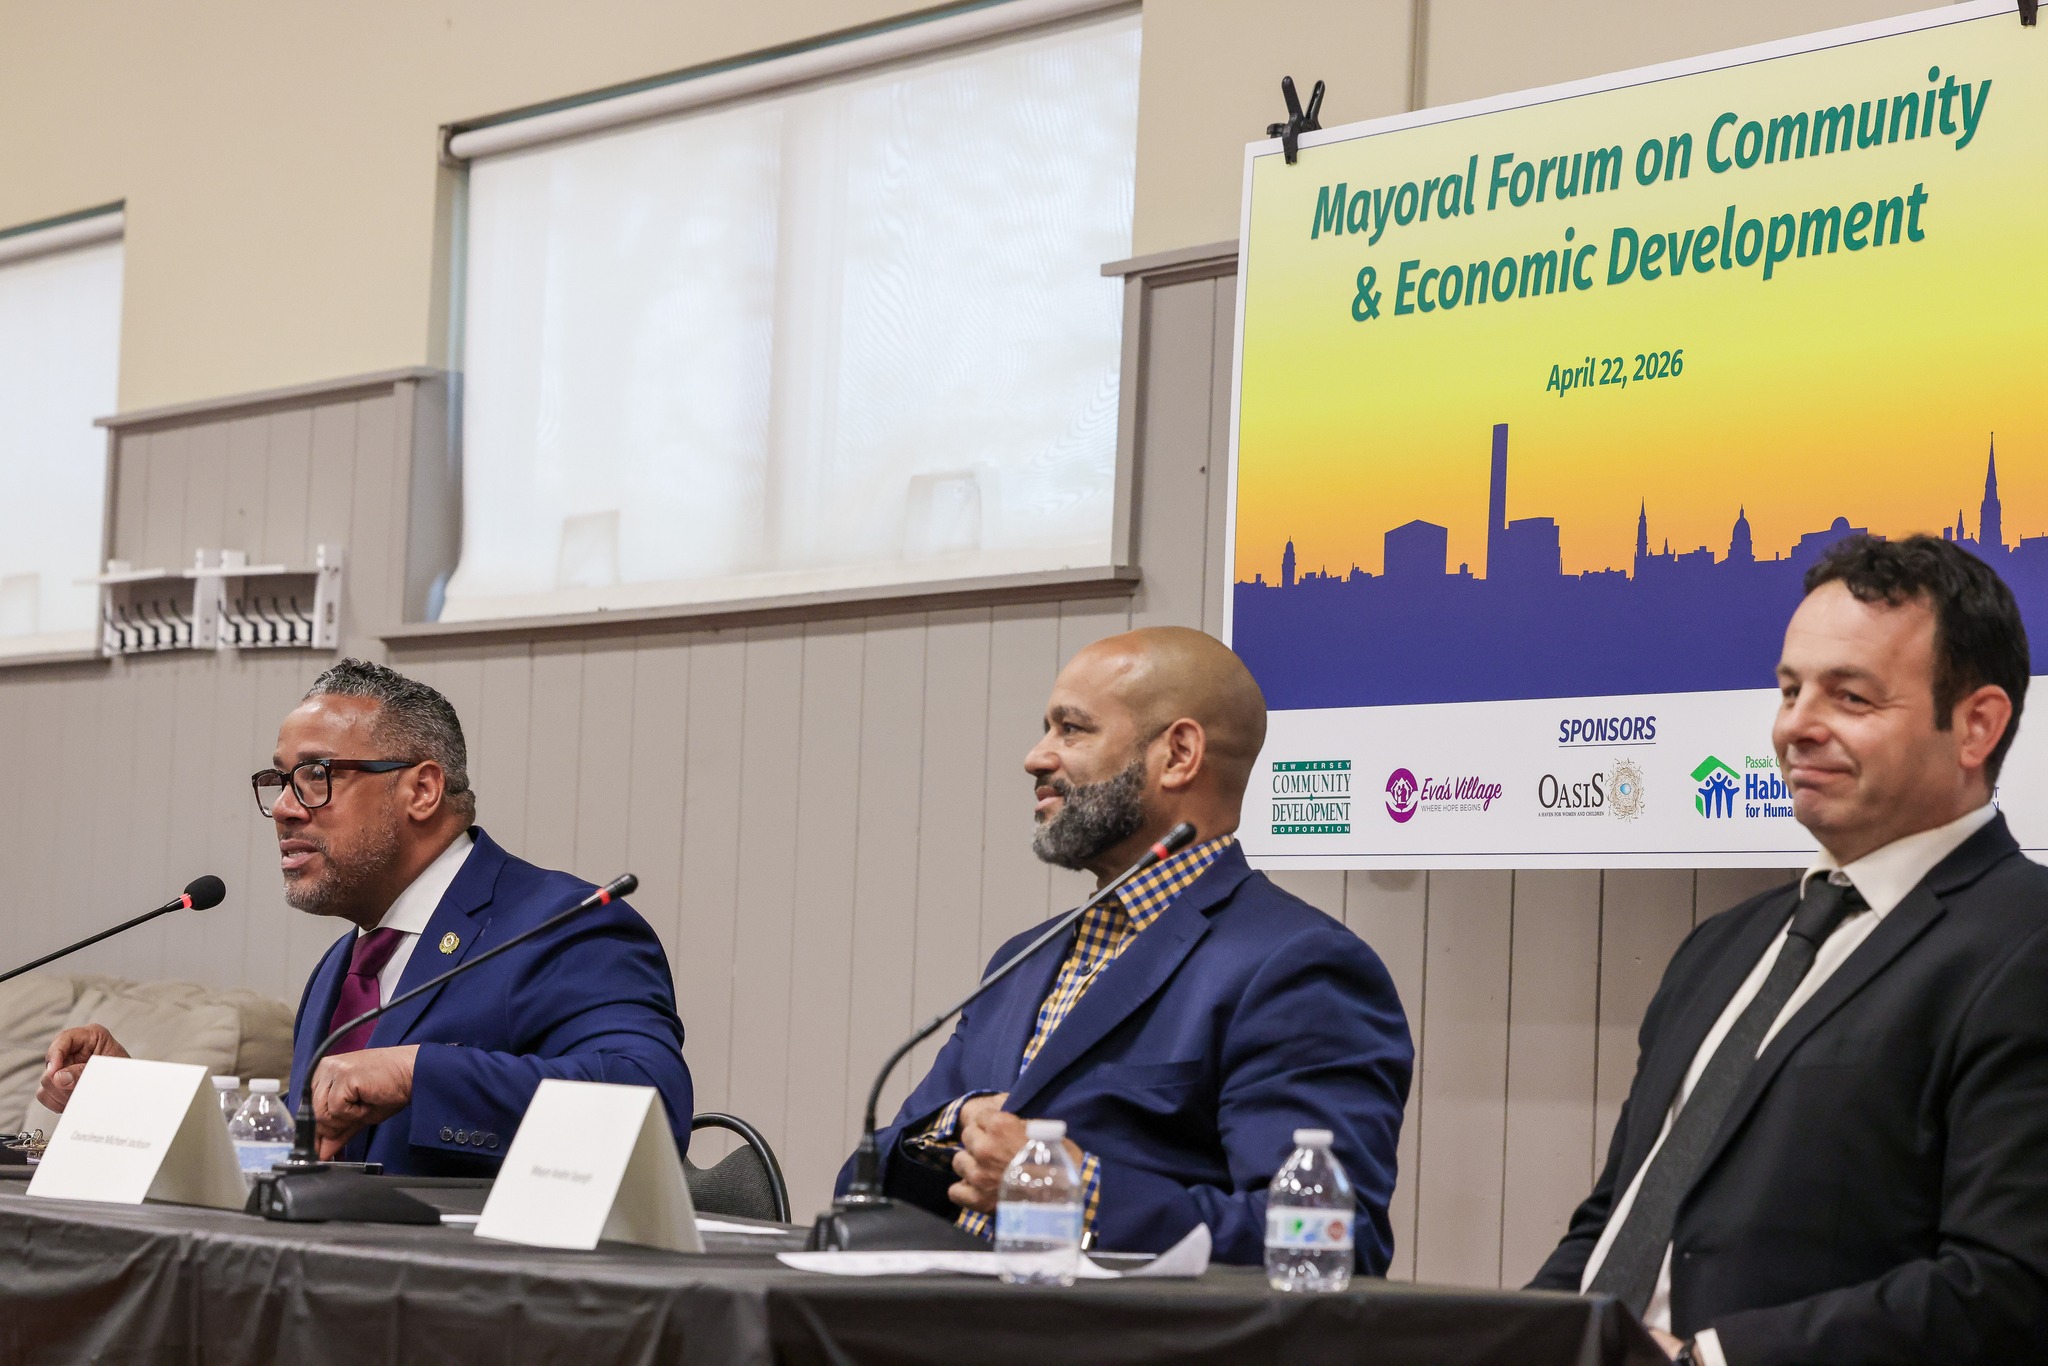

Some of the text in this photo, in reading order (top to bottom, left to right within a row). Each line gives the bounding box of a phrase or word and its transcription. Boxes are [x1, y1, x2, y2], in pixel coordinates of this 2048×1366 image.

[1311, 65, 1993, 247] Mayoral Forum on Community
[1351, 182, 1929, 322] & Economic Development
[1546, 348, 1684, 398] April 22, 2026
[1558, 715, 1657, 744] SPONSORS
[1273, 762, 1351, 771] NEW JERSEY
[1745, 755, 1774, 769] Passaic
[1272, 773, 1352, 794] COMMUNITY
[1420, 775, 1503, 812] Eva's Village
[1745, 772, 1793, 800] Habi
[1272, 802, 1351, 822] DEVELOPMENT
[1420, 803, 1482, 812] WHERE HOPE BEGINS
[1745, 802, 1796, 818] for Huma
[1272, 825, 1350, 833] CORPORATION
